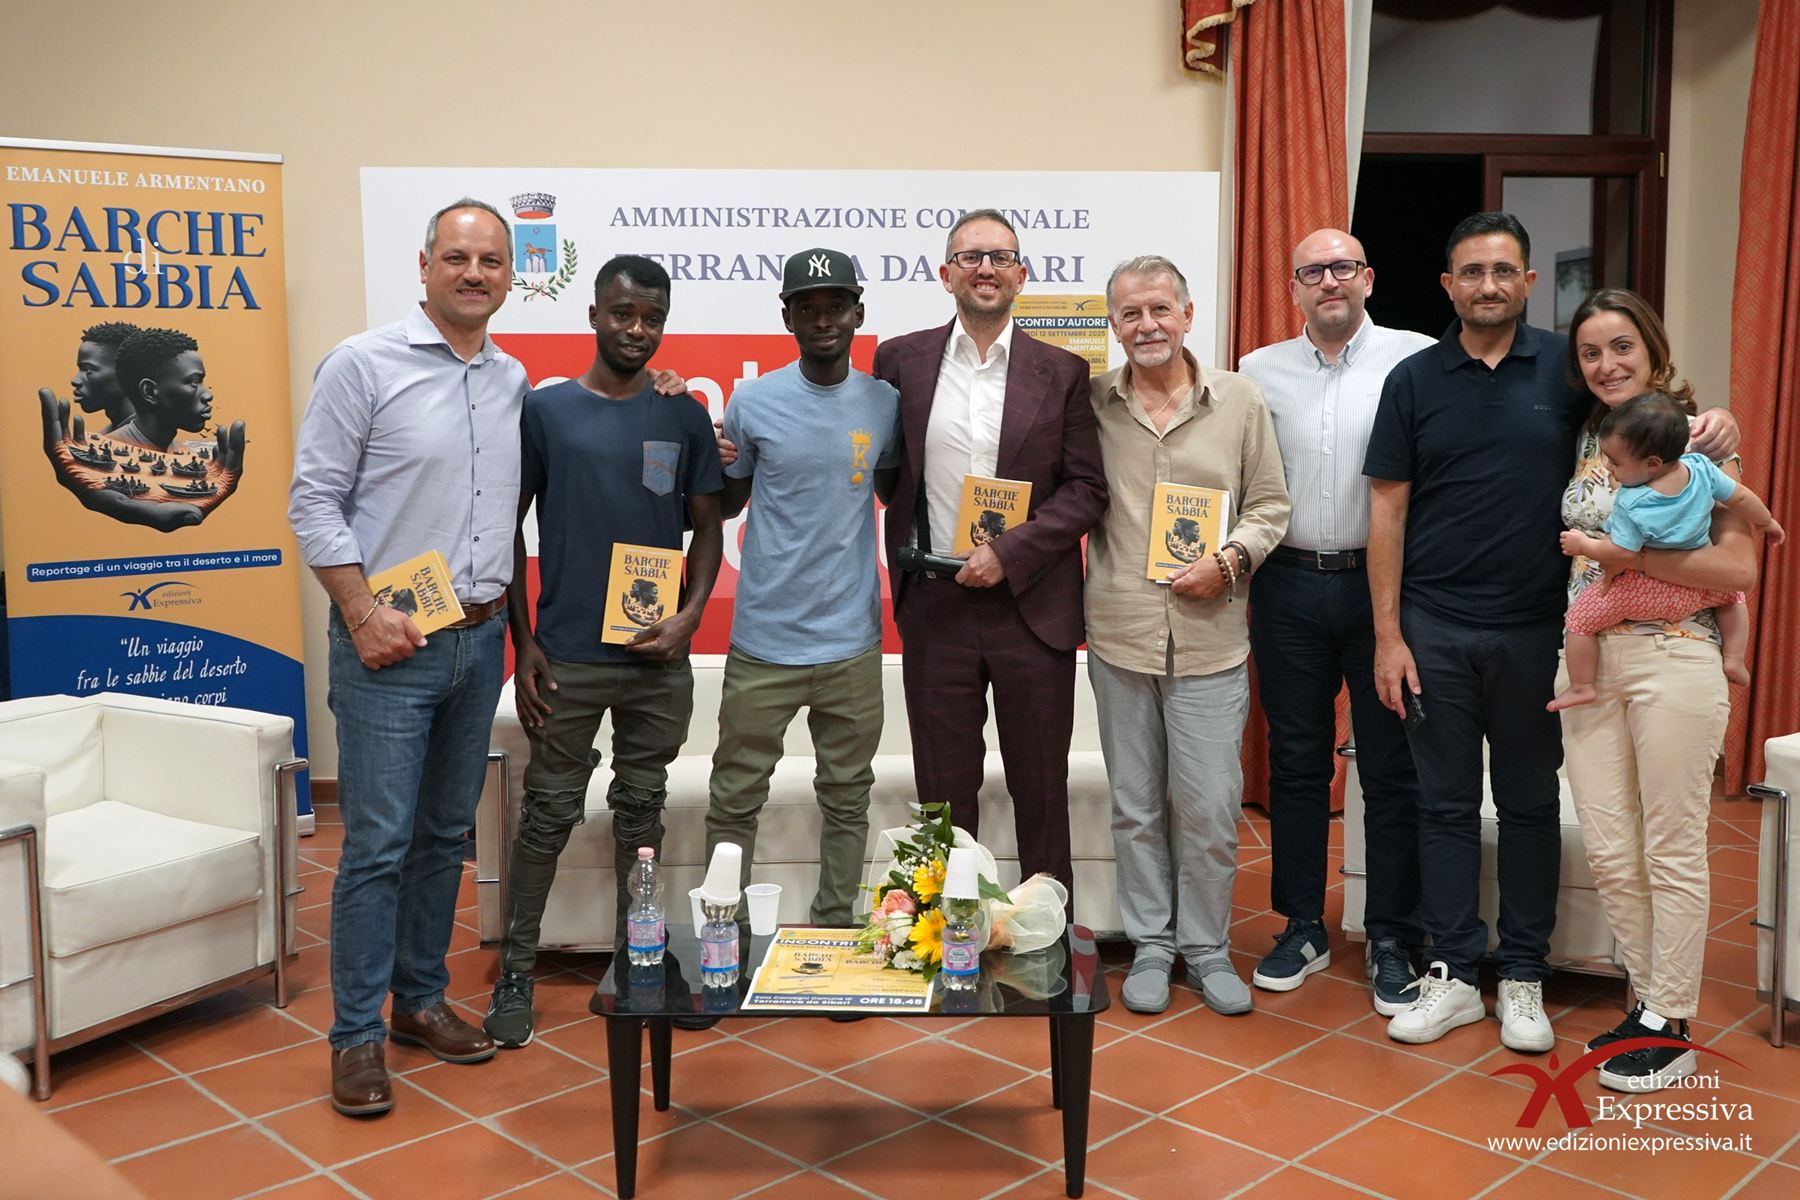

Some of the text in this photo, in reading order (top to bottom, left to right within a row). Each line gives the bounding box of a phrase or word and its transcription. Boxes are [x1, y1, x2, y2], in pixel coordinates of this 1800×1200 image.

[6, 166, 266, 194] EMANUELE ARMENTANO
[7, 202, 267, 258] BARCHE
[609, 206, 1090, 230] AMMINISTRAZIONE CONALE
[123, 238, 165, 276] di
[808, 253, 832, 278] NY
[880, 255, 937, 283] DA
[21, 260, 262, 311] SABBIA
[1016, 318, 1056, 327] CONTRI
[974, 486, 1019, 502] BARCHE
[974, 496, 1015, 511] SABBIA
[1166, 494, 1212, 508] BARCHE
[1166, 505, 1208, 518] SABBIA
[31, 565, 91, 578] Reportage
[94, 563, 104, 573] di
[107, 563, 121, 571] un
[124, 559, 163, 571] viaggio
[165, 559, 181, 568] tra
[183, 557, 190, 567] il
[192, 555, 232, 566] deserto
[243, 554, 250, 563] il
[252, 553, 278, 562] mare
[624, 554, 672, 569] BARCHE
[624, 565, 668, 580] SABBIA
[161, 589, 192, 598] edizioni
[410, 572, 436, 618] SABBIA
[419, 566, 448, 615] BARCHE
[153, 597, 202, 609] Expressiva
[157, 635, 204, 659] viaggio
[76, 655, 247, 691] fra le sabbie del deserto
[194, 686, 228, 706] corpi
[779, 939, 854, 947] INCONTRI
